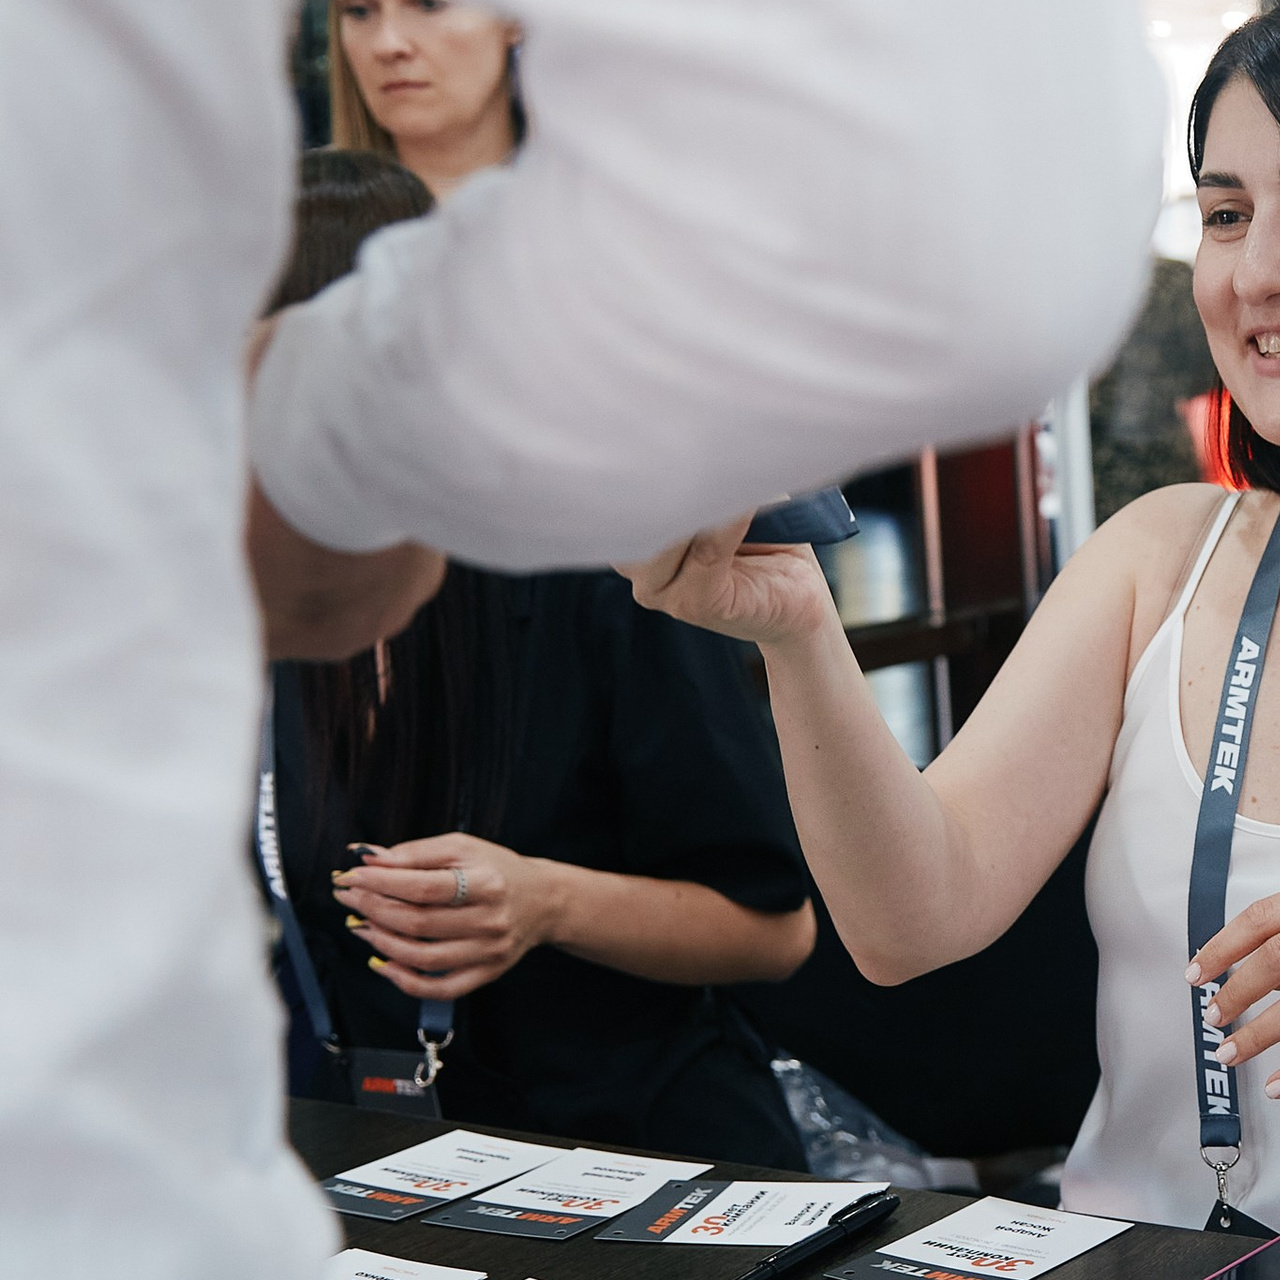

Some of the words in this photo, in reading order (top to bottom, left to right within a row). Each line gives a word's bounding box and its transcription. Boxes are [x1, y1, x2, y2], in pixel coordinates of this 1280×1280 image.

[1211, 635, 1261, 795] ARMTEK
[324, 1182, 424, 1207] ARMTEK
[559, 1197, 620, 1211] 30
[465, 1205, 582, 1225] ARMTEK
[644, 1187, 715, 1233] ARMTEK
[716, 1190, 770, 1226] компании
[781, 1202, 819, 1225] Валерий
[688, 1216, 734, 1235] 30
[718, 1203, 742, 1217] лет
[1009, 1220, 1055, 1232] Жосан
[993, 1225, 1047, 1238] Андрей
[921, 1240, 1014, 1261] компании
[945, 1251, 982, 1260] лет
[970, 1255, 1035, 1272] 30
